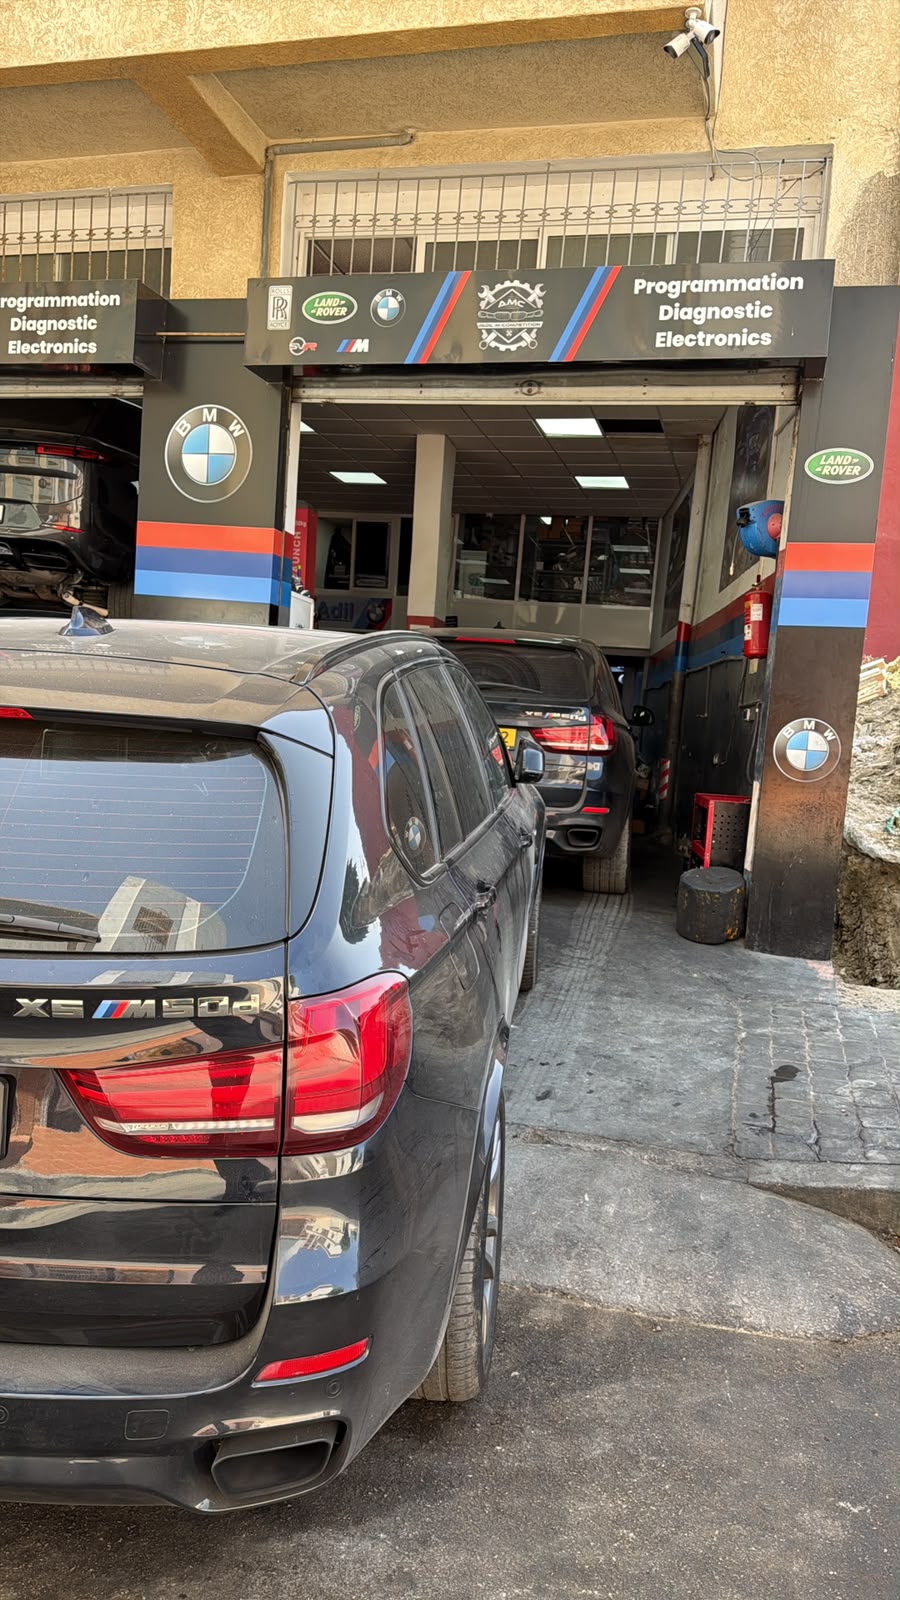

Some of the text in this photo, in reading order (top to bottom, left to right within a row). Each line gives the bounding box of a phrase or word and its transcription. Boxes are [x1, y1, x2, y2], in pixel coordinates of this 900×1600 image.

[633, 272, 804, 299] Programmation
[0, 290, 120, 312] rogrammation
[313, 298, 341, 307] LAND
[374, 289, 403, 303] BMW
[498, 299, 526, 308] AMC
[315, 307, 348, 316] ROVER
[658, 300, 774, 325] Diagnostic
[10, 315, 98, 335] Diagnostic
[7, 339, 97, 354] Electronics
[655, 328, 772, 348] Electronics
[175, 408, 245, 438] BMW
[819, 455, 852, 465] LAND
[821, 465, 862, 476] ROVER
[292, 531, 302, 577] AUNCH
[781, 720, 836, 742] BMW
[13, 998, 84, 1018] X5
